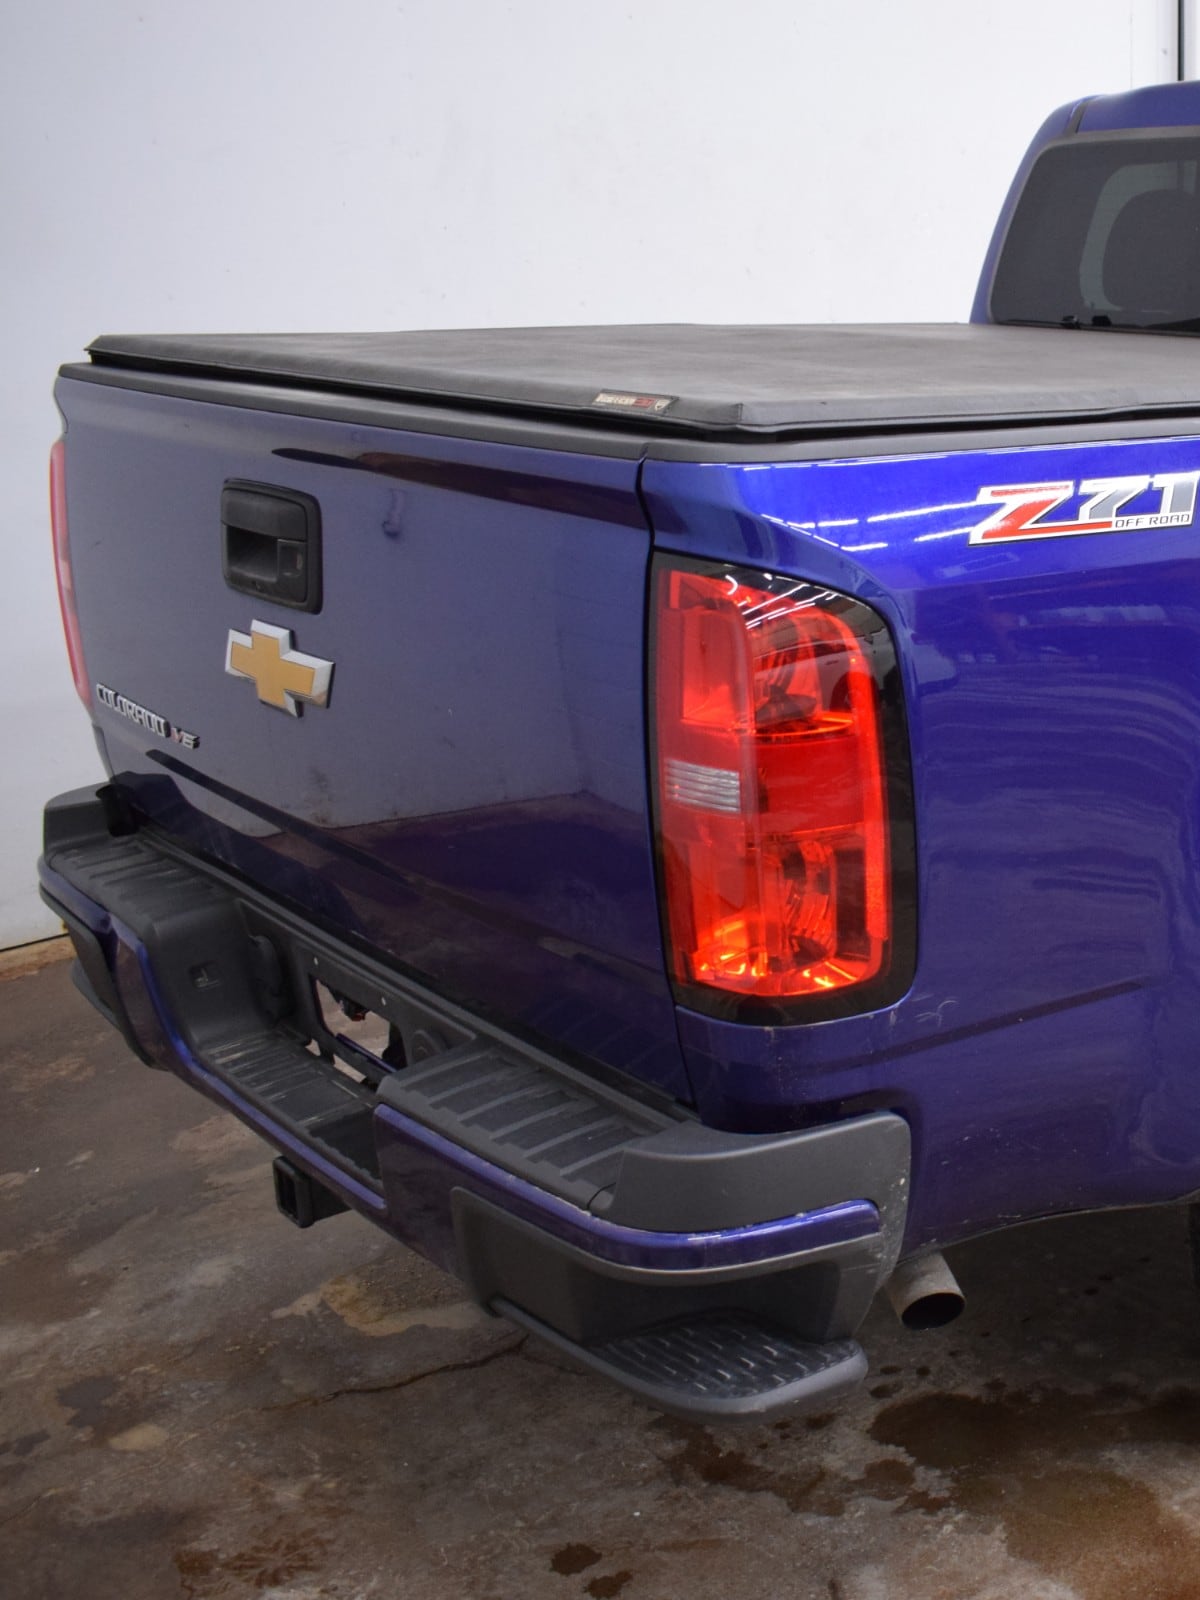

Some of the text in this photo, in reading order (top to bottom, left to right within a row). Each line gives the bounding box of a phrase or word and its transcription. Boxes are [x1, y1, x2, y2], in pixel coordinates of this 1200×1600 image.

[968, 472, 1200, 546] Z71
[1114, 513, 1190, 529] OFF ROAD
[96, 683, 200, 750] COLORADO V6
